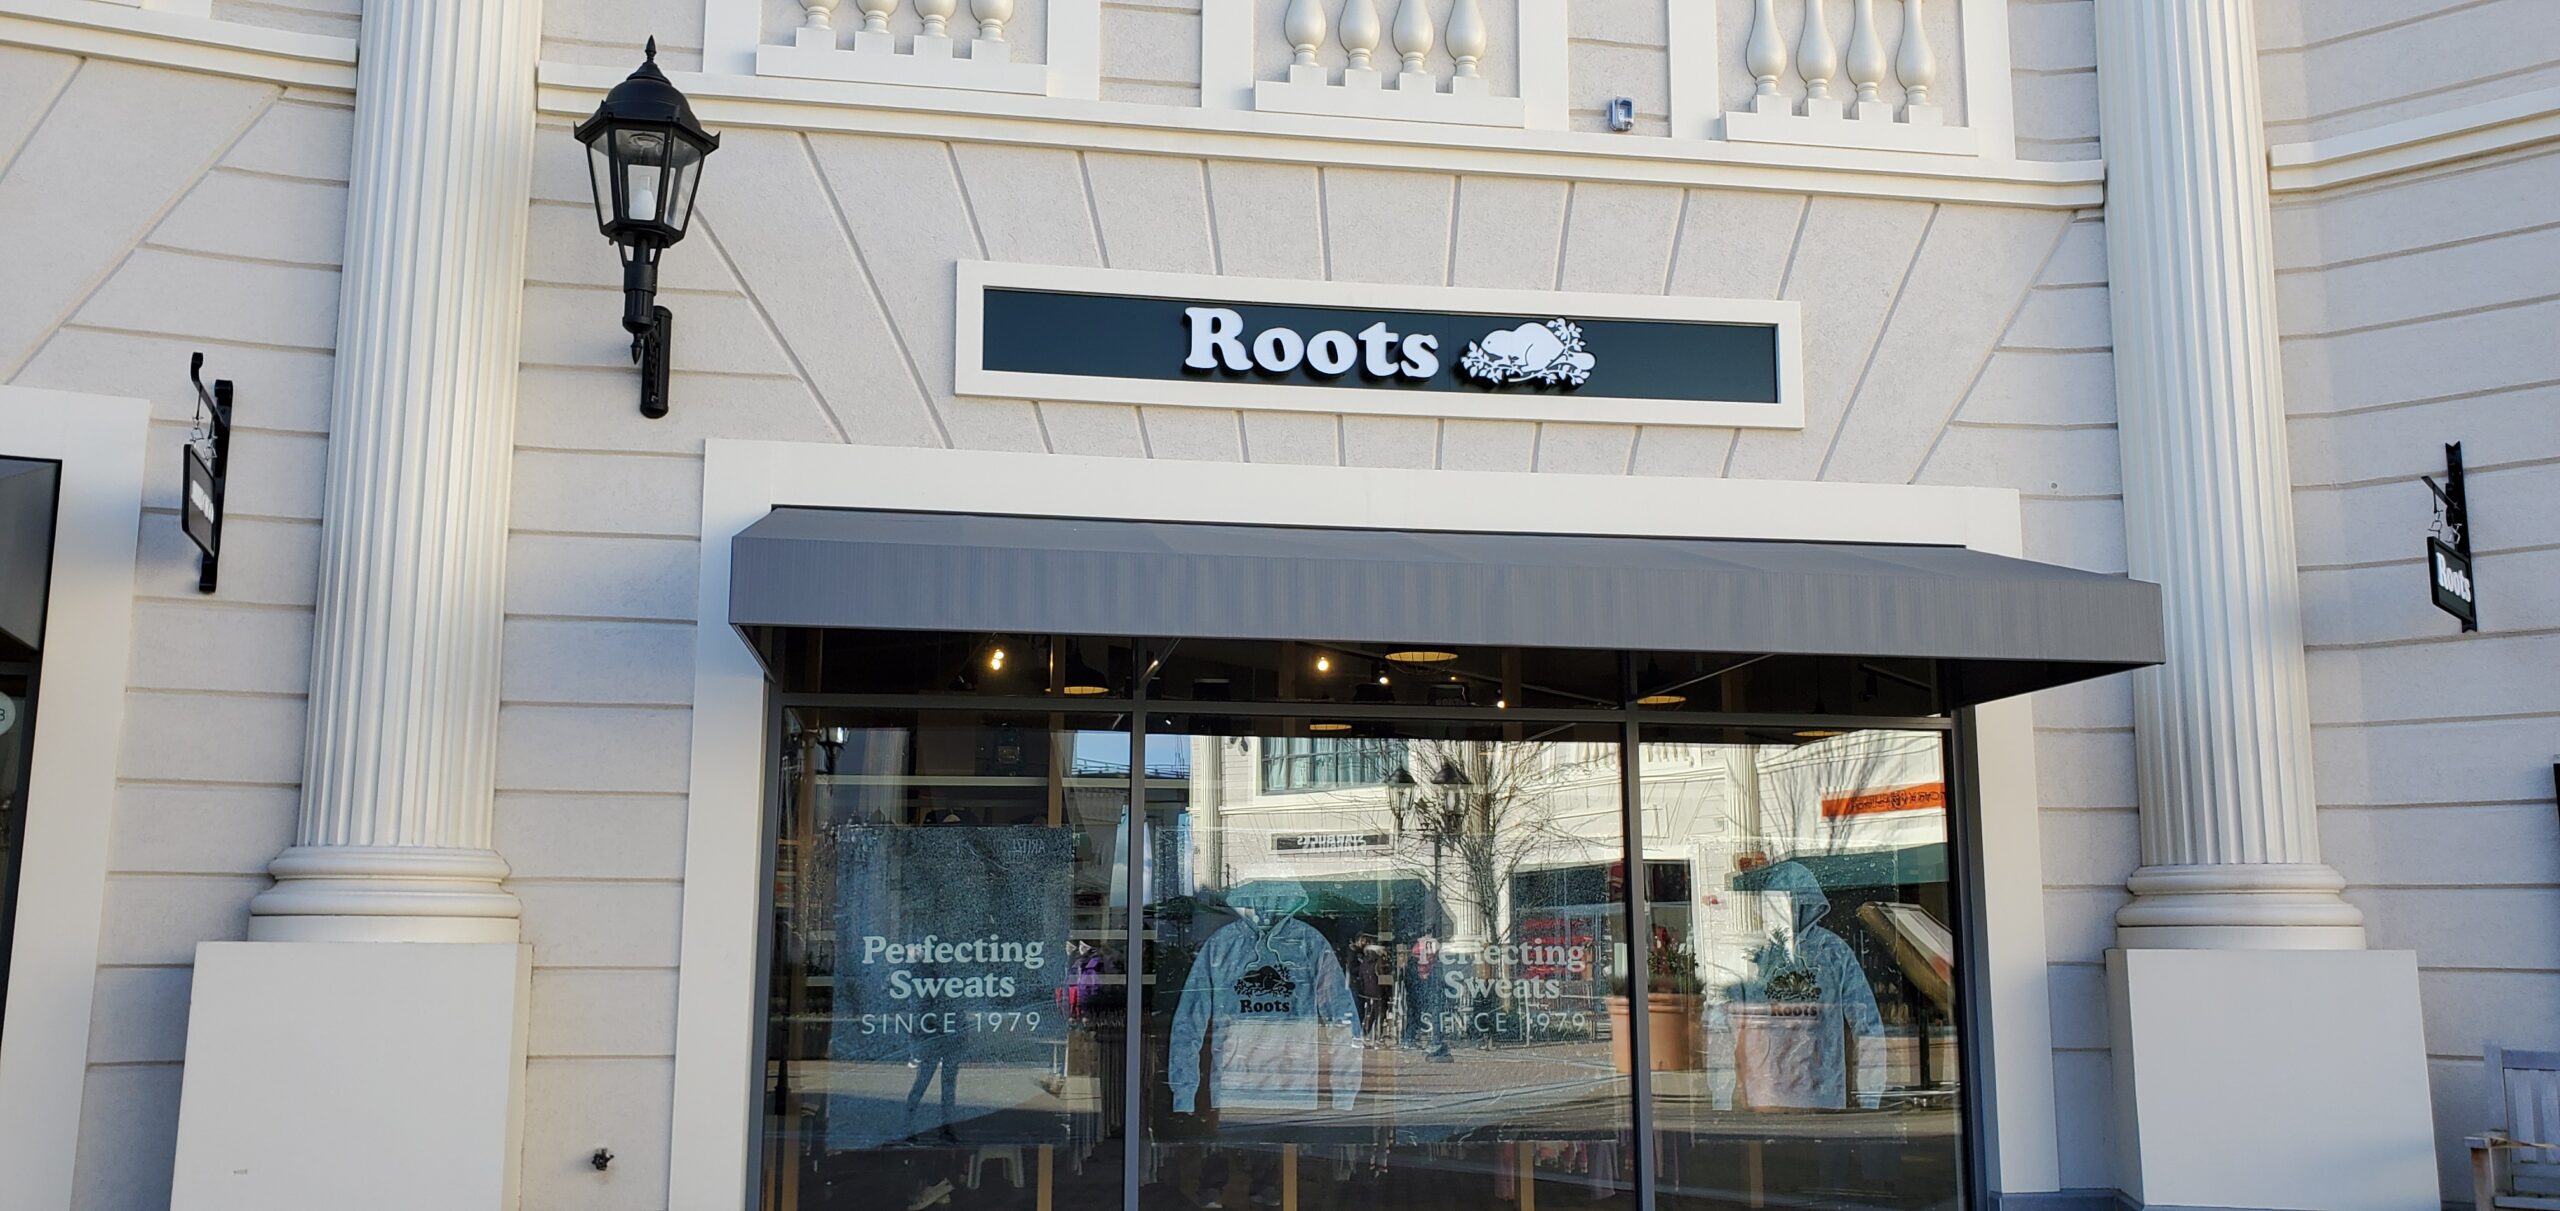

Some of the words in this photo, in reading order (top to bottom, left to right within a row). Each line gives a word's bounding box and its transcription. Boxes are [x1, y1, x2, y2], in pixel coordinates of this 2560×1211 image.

[1184, 306, 1440, 379] Roots
[2435, 551, 2472, 603] Roots
[862, 934, 1045, 968] Perfecting
[1417, 937, 1586, 973] Perfecting
[889, 969, 1016, 1000] Sweats
[1444, 970, 1561, 1000] Sweats
[1239, 999, 1290, 1013] Roots
[1770, 1003, 1818, 1017] Roots
[861, 1012, 956, 1035] SINCE
[974, 1011, 1041, 1033] 1979
[1420, 1012, 1508, 1034] SINCE
